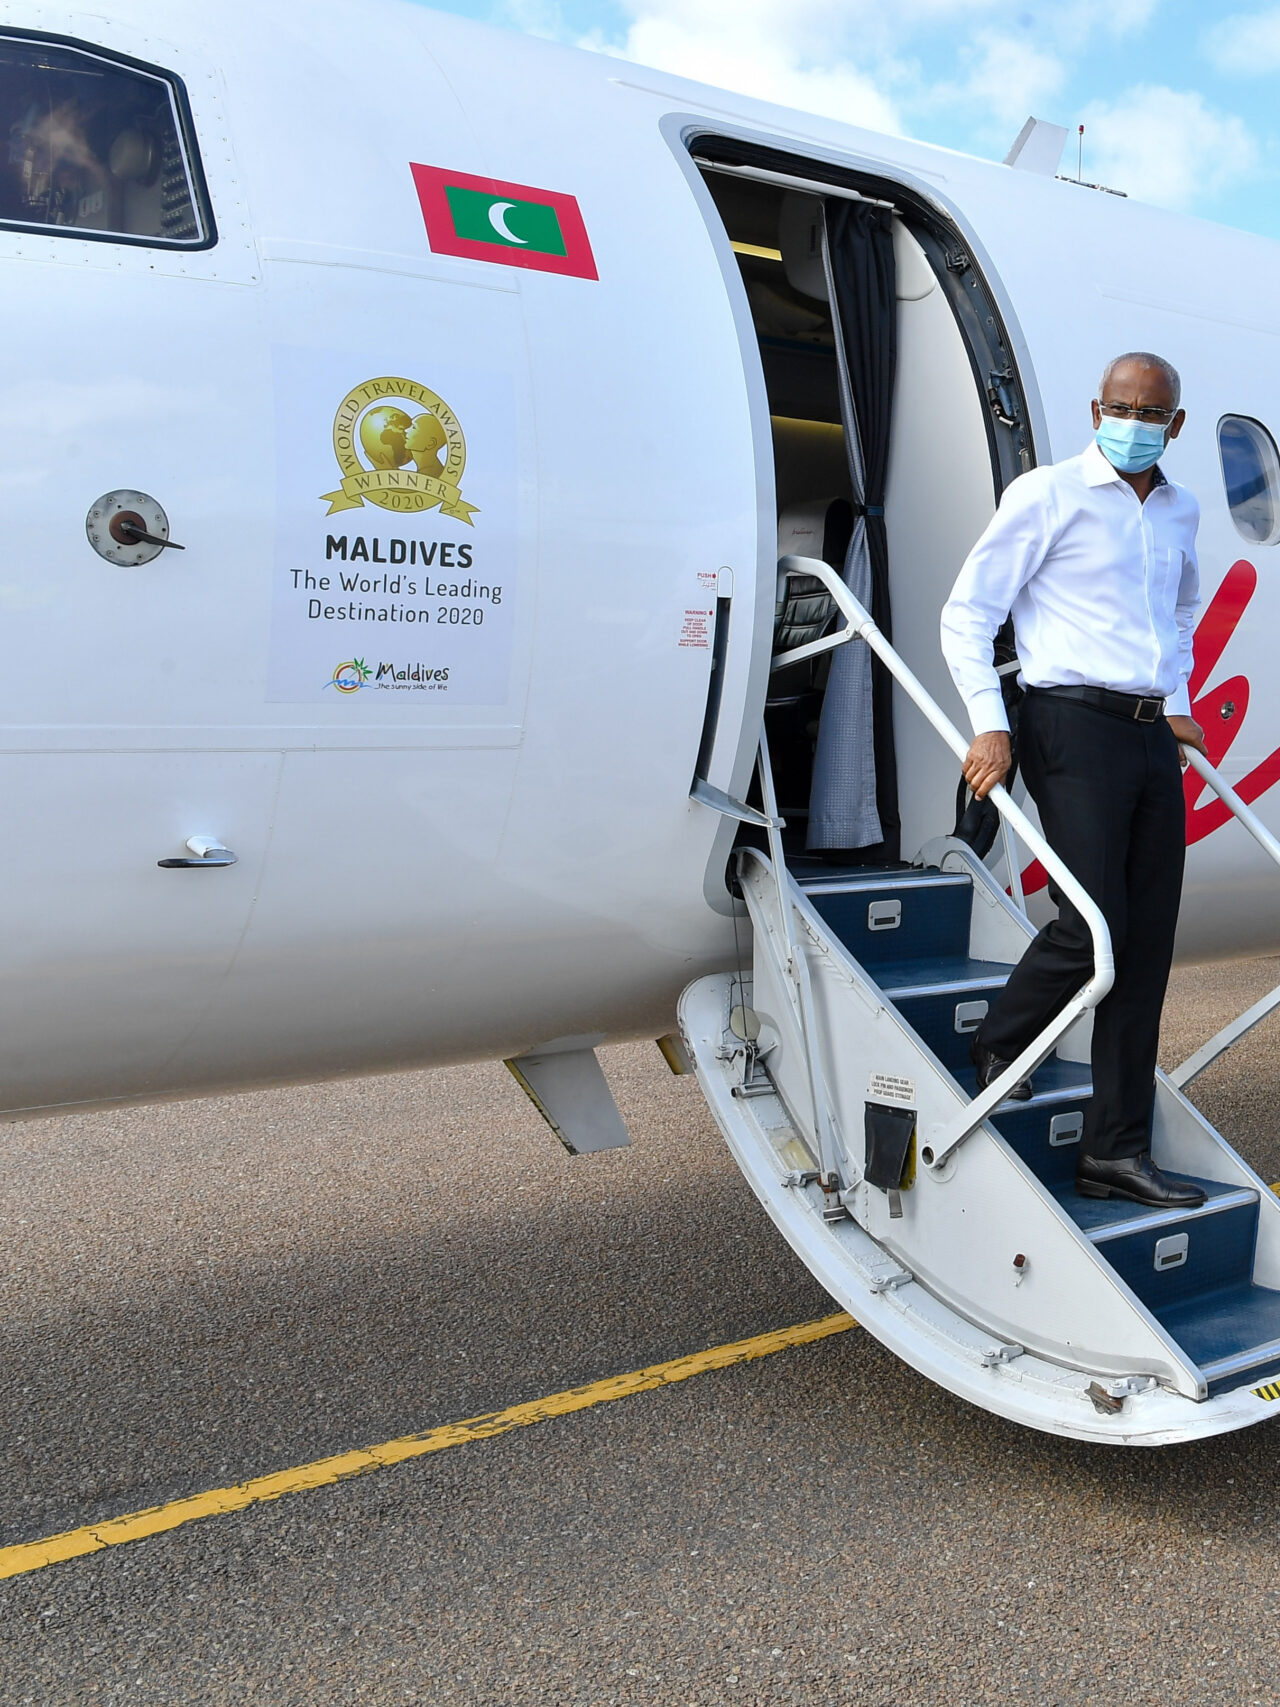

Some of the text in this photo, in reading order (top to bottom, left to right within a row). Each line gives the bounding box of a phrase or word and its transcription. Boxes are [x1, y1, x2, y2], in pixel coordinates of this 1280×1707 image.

[338, 381, 462, 477] WORLD TRAVEL AWARDS
[354, 473, 447, 498] WINNER
[379, 492, 424, 510] 2020
[326, 534, 473, 568] MALDIVES
[290, 569, 503, 604] The World's Leading
[308, 599, 484, 625] Destination 2020
[375, 661, 449, 683] Maldives
